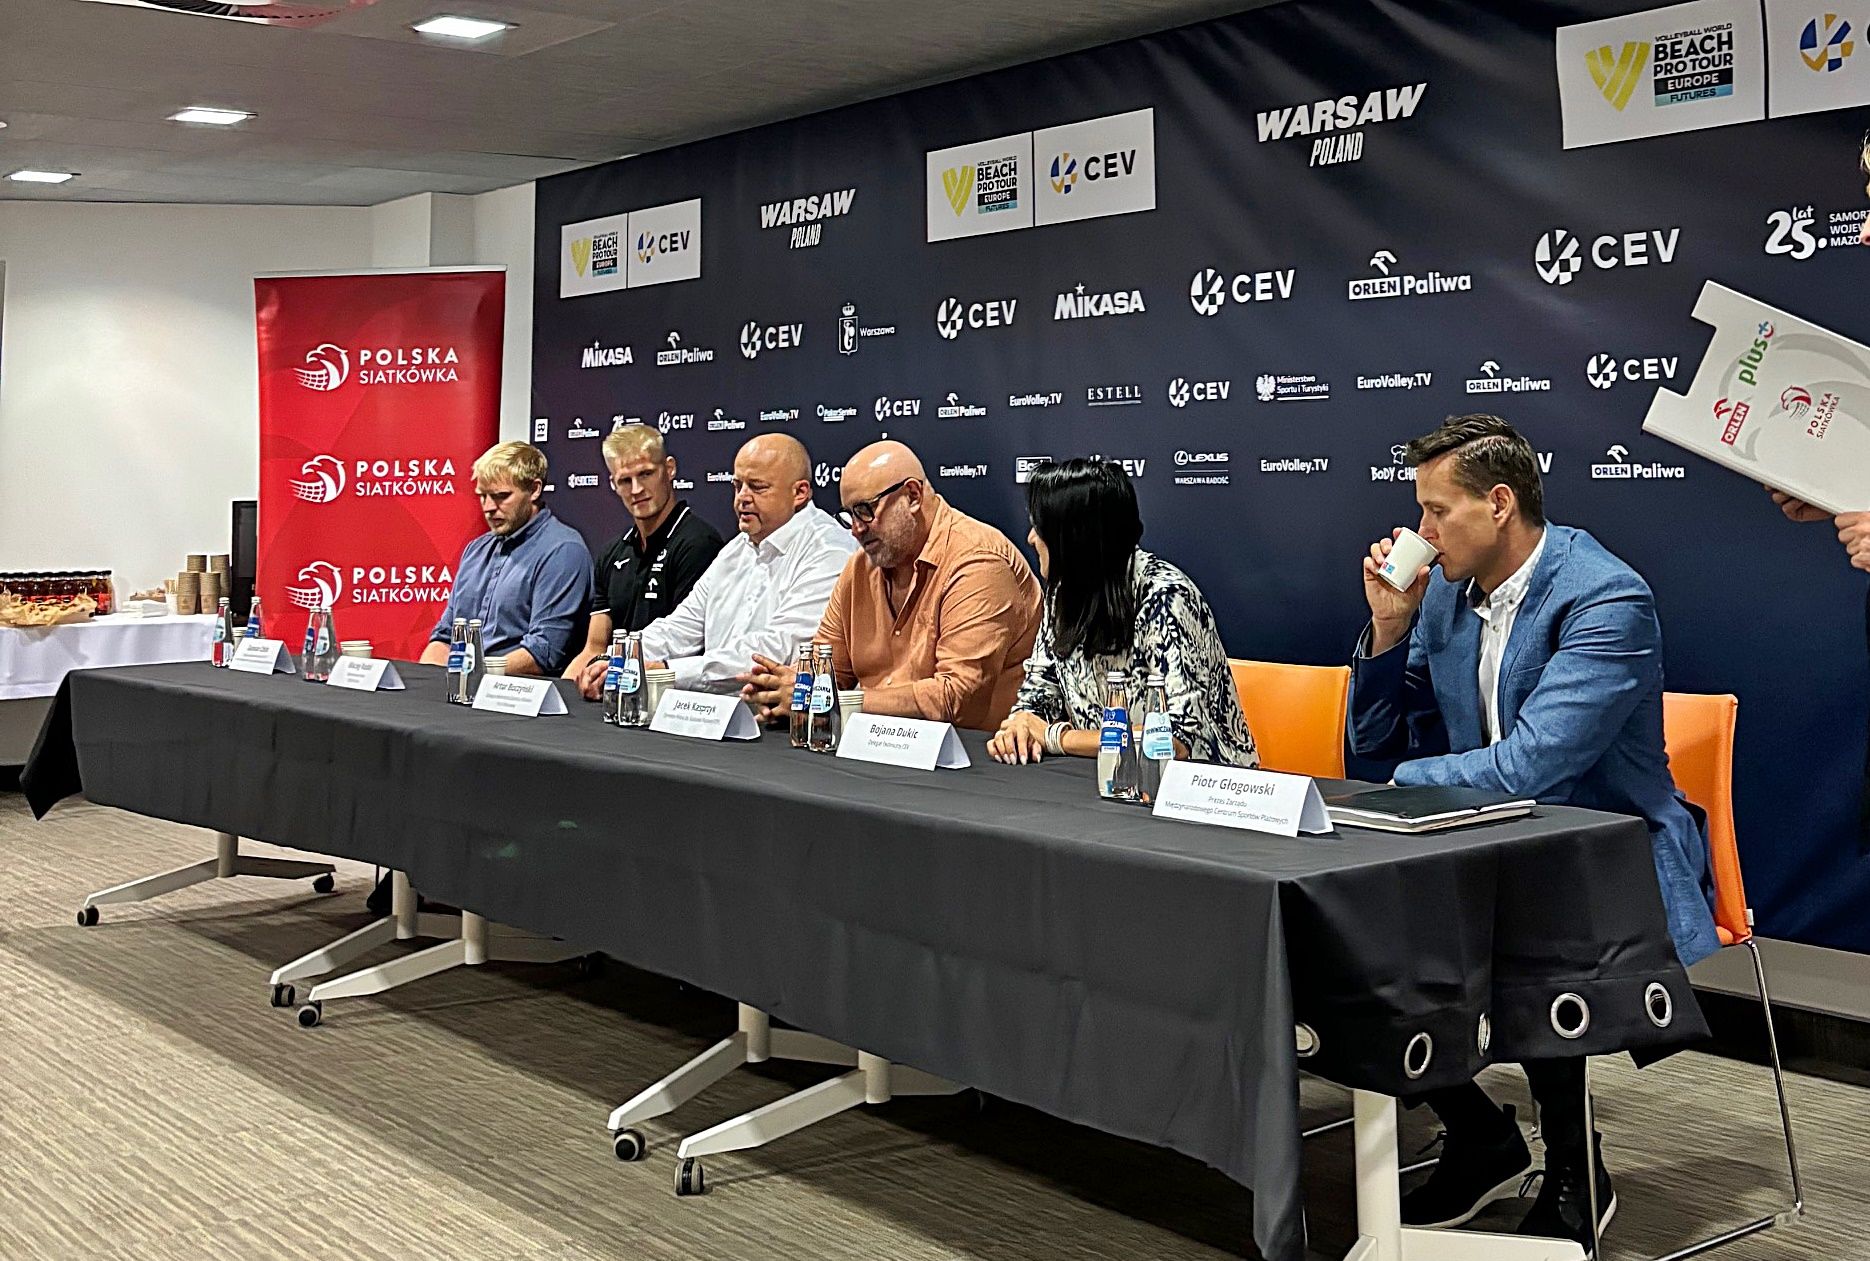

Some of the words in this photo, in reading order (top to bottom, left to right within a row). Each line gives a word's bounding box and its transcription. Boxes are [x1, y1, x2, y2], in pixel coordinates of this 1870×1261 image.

[1655, 29, 1702, 41] VOLLEYBALL
[1704, 23, 1732, 33] WORLD
[1654, 31, 1733, 62] BEACH
[1654, 60, 1687, 77] PRO
[1690, 53, 1733, 71] TOUR
[1667, 73, 1719, 90] EUROPE
[1670, 88, 1716, 102] FUTURES
[1257, 83, 1427, 142] WARSAW
[1310, 132, 1363, 167] POLAND
[977, 161, 1017, 182] BEACH
[1084, 149, 1137, 181] CEV
[978, 181, 994, 193] PRO
[995, 176, 1017, 190] TOUR
[984, 191, 1011, 203] EUROPE
[760, 188, 856, 228] WARSAW
[1792, 205, 1814, 221] lat
[592, 236, 618, 251] BEACH
[658, 229, 690, 254] CEV
[790, 223, 822, 249] POLAND
[1591, 228, 1680, 269] CEV
[1231, 269, 1295, 303] CEV
[1351, 279, 1398, 297] ORLEN
[1403, 272, 1471, 295] Paliwa
[968, 299, 1017, 329] CEV
[765, 323, 803, 349] CEV
[859, 325, 895, 338] Warszawa
[359, 347, 459, 366] POLSKA
[657, 351, 681, 365] ORLEN
[682, 347, 713, 363] Paliwa
[1738, 338, 1769, 386] plus
[359, 364, 458, 384] SIATKÓWKA
[1623, 357, 1678, 381] CEV
[1277, 375, 1316, 384] Ministerstwo
[1277, 385, 1297, 394] Sportu
[1302, 383, 1329, 394] Turystyki
[1357, 372, 1432, 390] EuroVolley.TV
[1468, 381, 1500, 391] ORLEN
[1503, 376, 1550, 392] Paliwa
[1009, 392, 1062, 407] EuroVolley.TV
[1088, 386, 1141, 400] ESTELL
[1192, 381, 1230, 400] CEV
[893, 400, 921, 416] CEV
[959, 406, 986, 417] Paliwa
[1807, 392, 1832, 436] POLSKA
[1816, 396, 1840, 439] SIATKÓWKA
[672, 414, 694, 430] CEV
[1723, 404, 1748, 443] ORLEN
[1189, 453, 1229, 462] LEXUS
[1260, 459, 1328, 474] EuroVolley.TV
[356, 458, 455, 478] POLSKA
[940, 465, 988, 478] EuroVolley.TV
[1112, 460, 1146, 477] EV
[1594, 466, 1628, 477] ORLEN
[1633, 464, 1684, 478] Paliwa
[356, 476, 455, 496] SIATKÓWKA
[353, 565, 452, 584] POLSKA
[352, 583, 451, 603] SIATKÓWKA
[673, 700, 690, 710] Jacek
[870, 724, 896, 737] Bojana
[1191, 775, 1217, 788] Piotr
[1220, 778, 1275, 796] Głogowski
